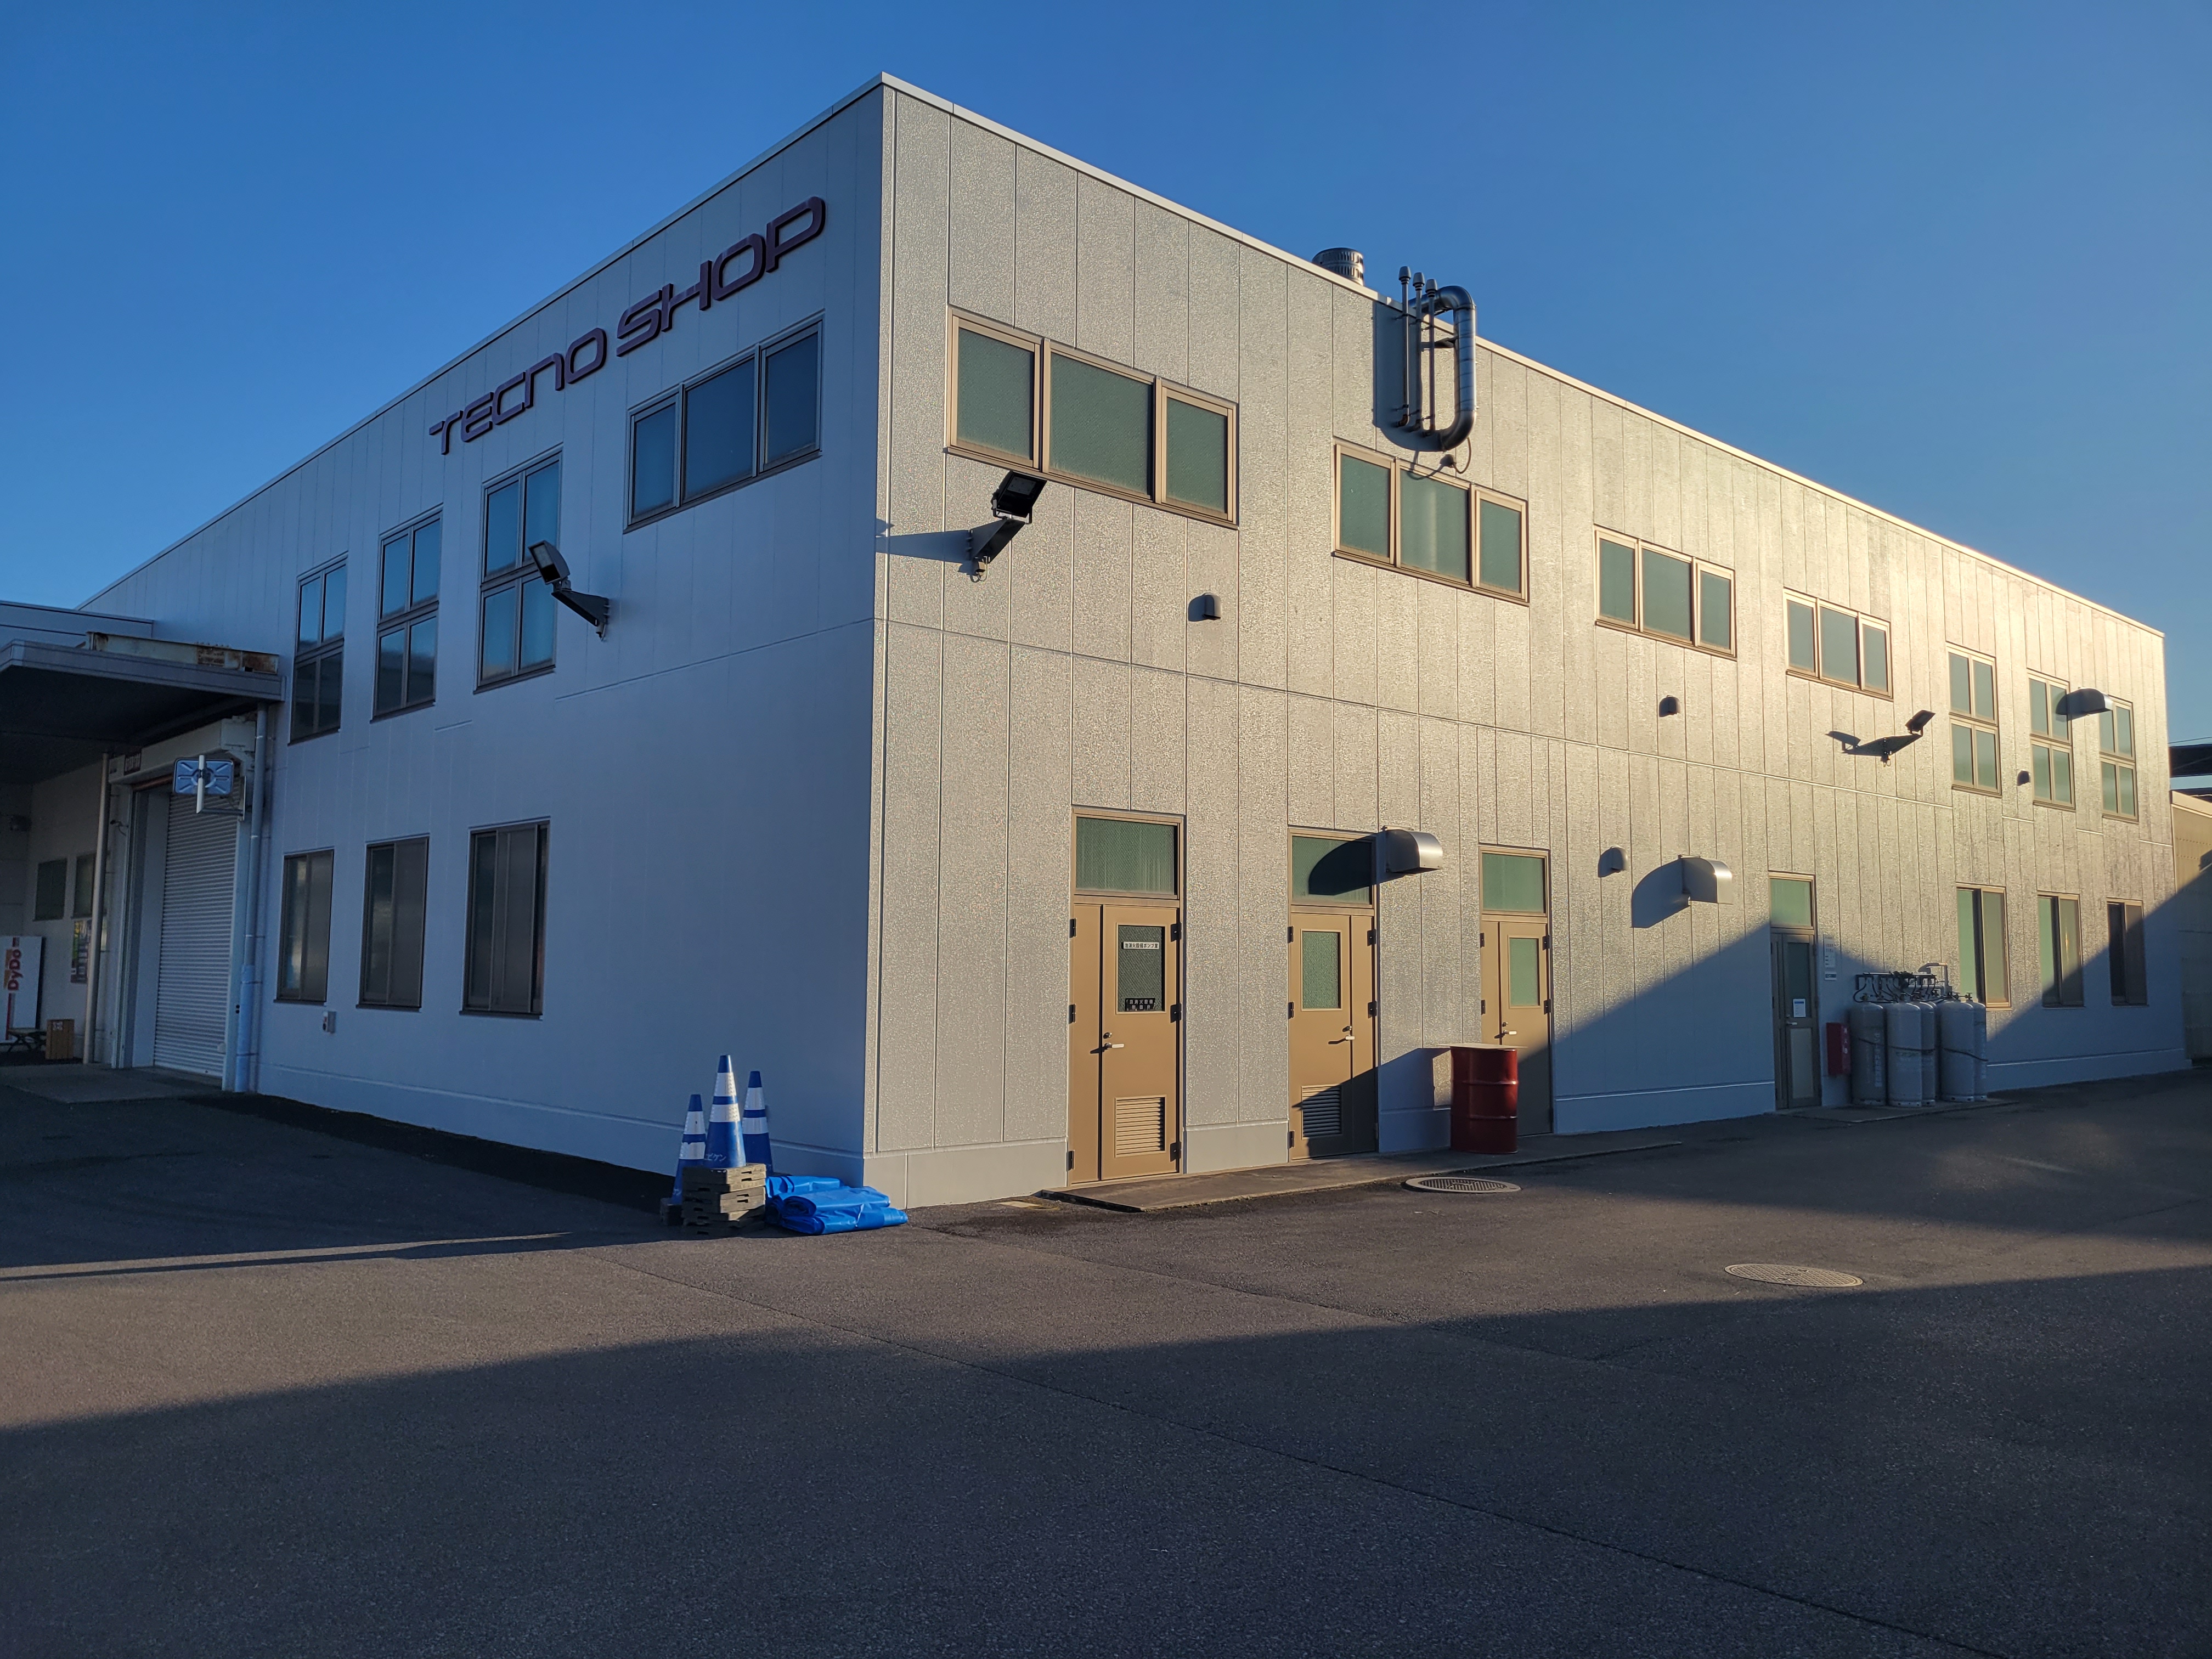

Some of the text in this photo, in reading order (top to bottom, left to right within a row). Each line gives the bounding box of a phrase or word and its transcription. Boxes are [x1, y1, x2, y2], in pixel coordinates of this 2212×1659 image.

[428, 196, 826, 455] TECNO SHOP
[7, 949, 24, 991] DyDo
